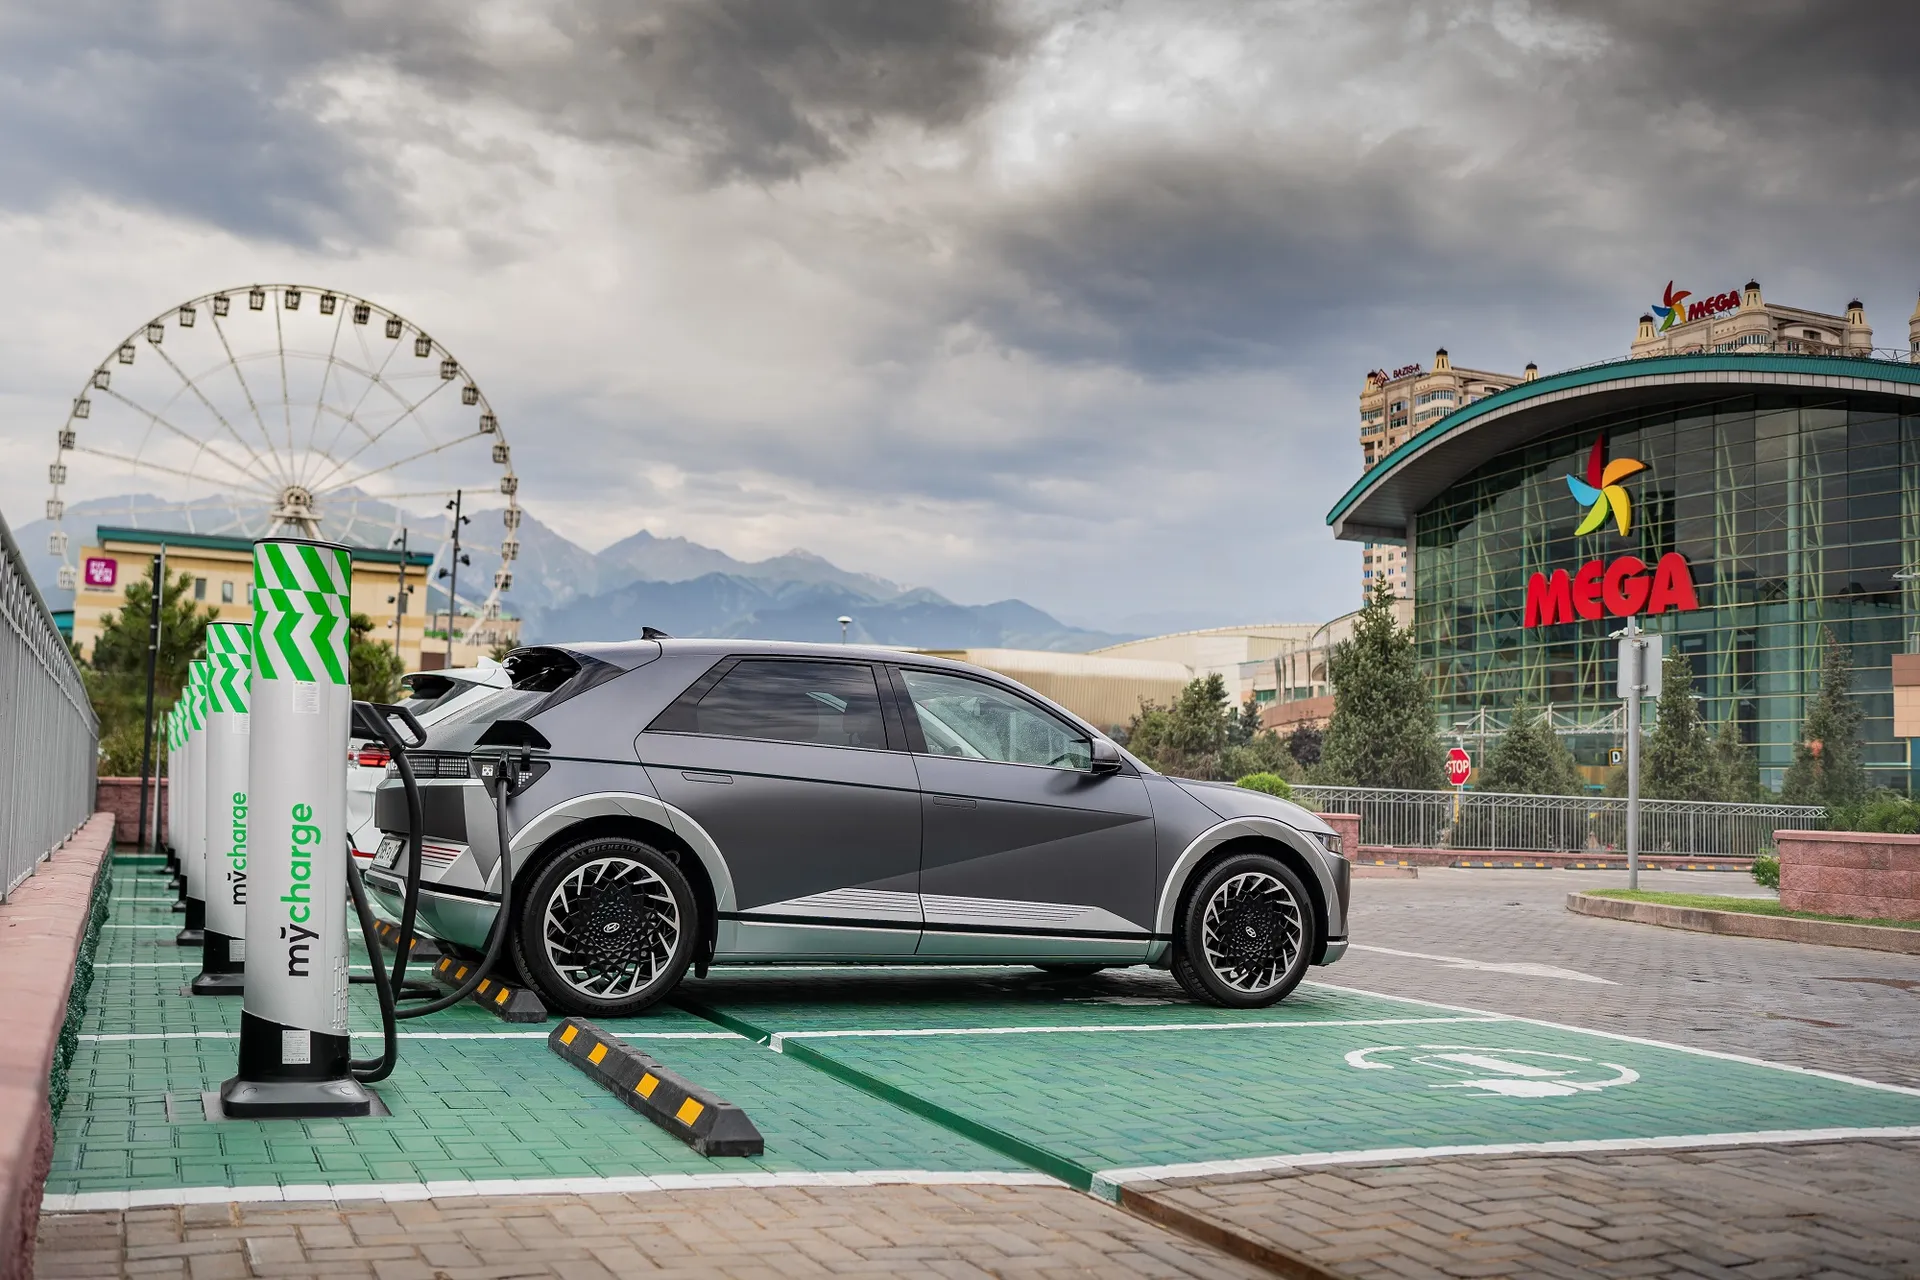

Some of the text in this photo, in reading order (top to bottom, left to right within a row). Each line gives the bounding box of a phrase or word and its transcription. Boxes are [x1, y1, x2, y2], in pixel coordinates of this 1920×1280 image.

[1687, 290, 1740, 321] MEGA
[1393, 363, 1420, 378] BAZIS-A
[1524, 552, 1699, 628] MEGA
[1445, 759, 1469, 774] STOP
